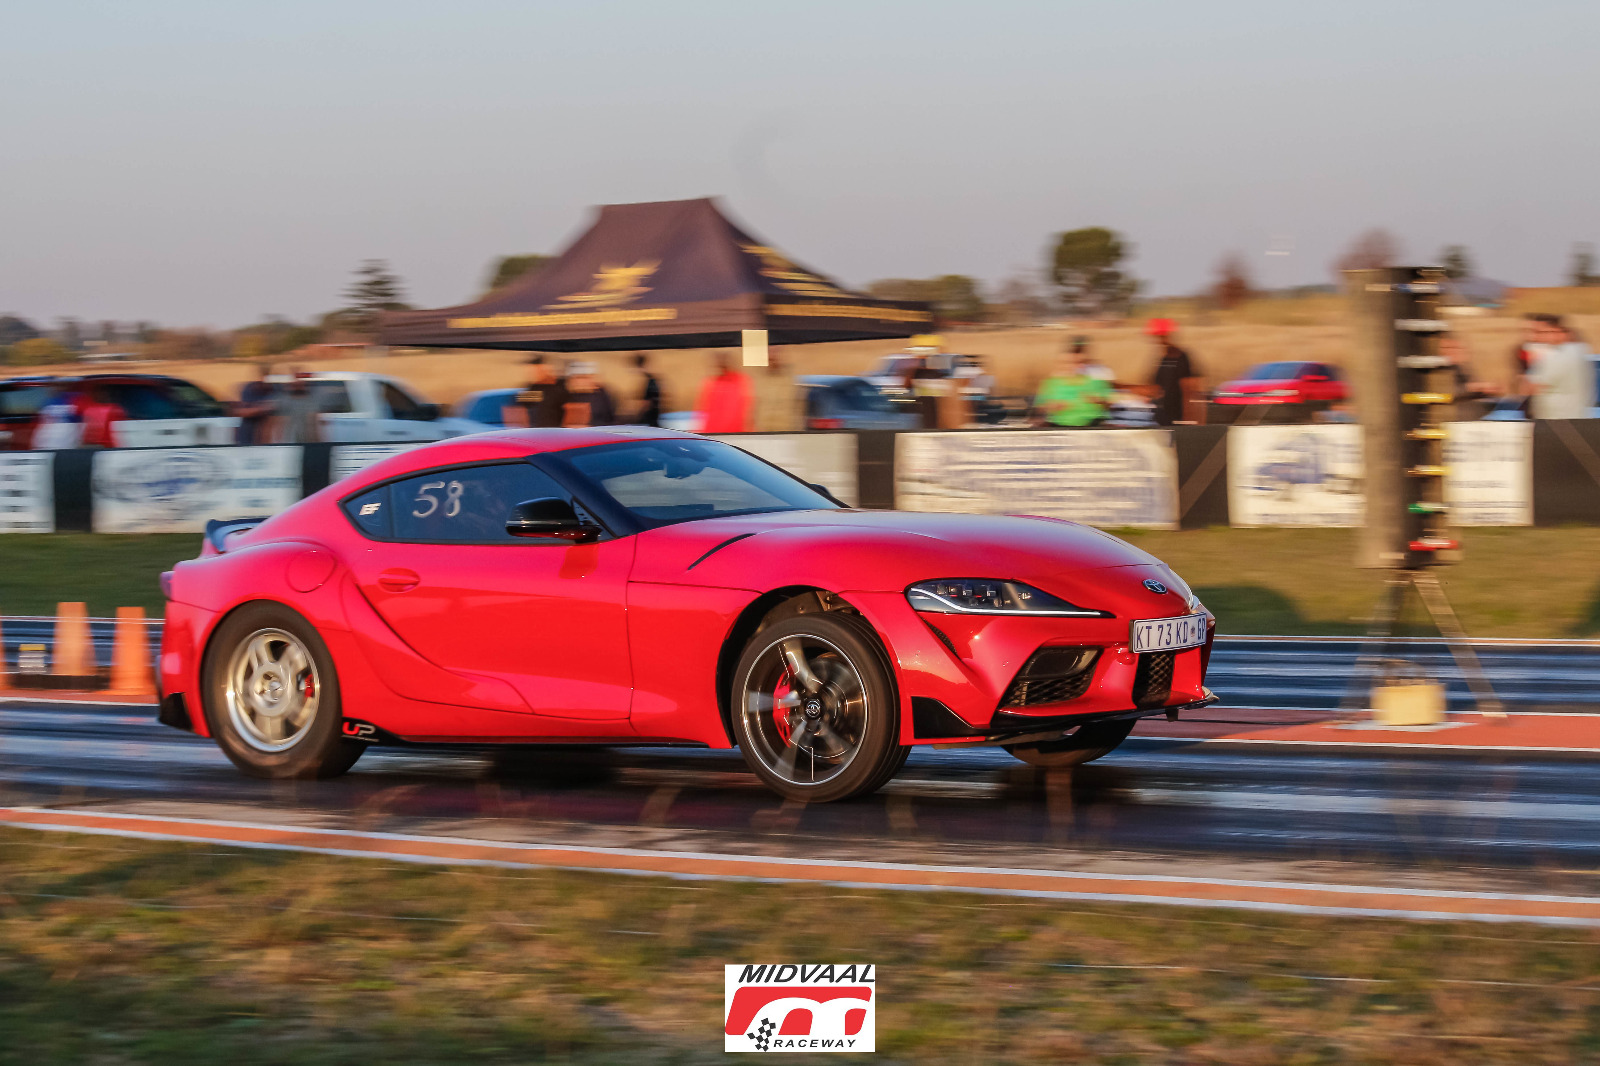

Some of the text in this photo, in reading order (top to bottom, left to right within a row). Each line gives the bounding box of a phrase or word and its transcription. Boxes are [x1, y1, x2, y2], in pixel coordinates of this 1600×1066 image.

[412, 480, 464, 518] 58
[1136, 617, 1206, 649] KT 73 KD GP
